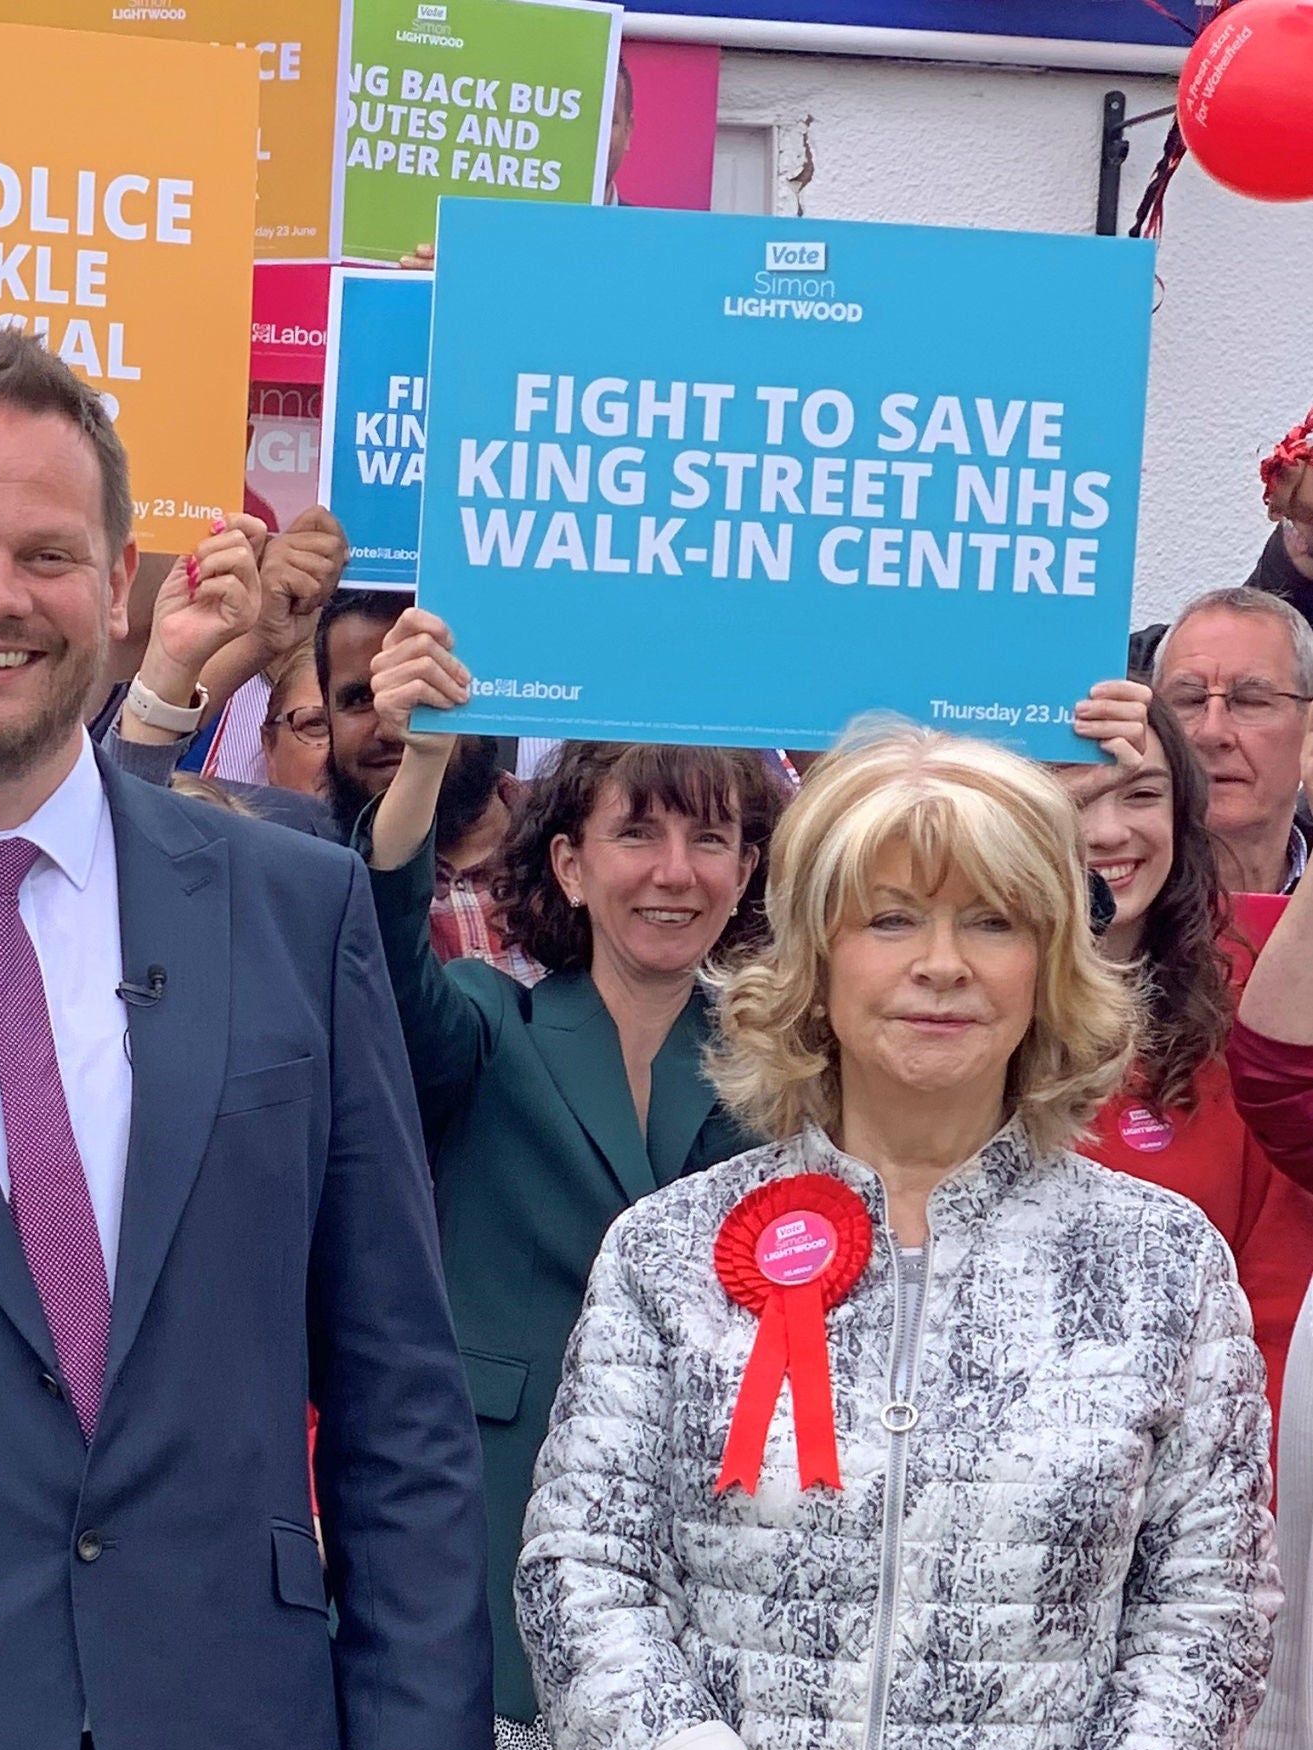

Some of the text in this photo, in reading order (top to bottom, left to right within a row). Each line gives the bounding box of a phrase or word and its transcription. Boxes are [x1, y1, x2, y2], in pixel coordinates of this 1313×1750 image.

[112, 8, 186, 20] LIGHTWOOD
[420, 6, 445, 18] Vote
[396, 30, 464, 48] LIGHTWOOD
[411, 19, 451, 34] Simon
[1189, 58, 1211, 99] fresh
[1209, 24, 1236, 57] start
[1195, 25, 1253, 128] for Wakefield
[401, 69, 501, 111] BACK
[509, 83, 583, 120] BUS
[456, 114, 540, 151] AND
[451, 150, 562, 191] FARES
[276, 226, 289, 237] 23
[291, 226, 317, 237] June
[771, 245, 820, 265] Vote
[754, 271, 835, 298] Simon
[724, 296, 862, 323] LIGHTWOOD
[513, 373, 1064, 461] FIGHT TO SAVE
[457, 438, 1111, 530] KING STREET NHS
[153, 499, 175, 517] 23
[178, 501, 223, 519] June
[388, 548, 418, 560] Labo
[460, 507, 1099, 597] WALK-IN CENTRE
[512, 680, 583, 701] Labour
[930, 700, 1076, 727] Thursday 23 Ju
[779, 1224, 803, 1236] Vote
[763, 1238, 827, 1263] LIGHTWOOD
